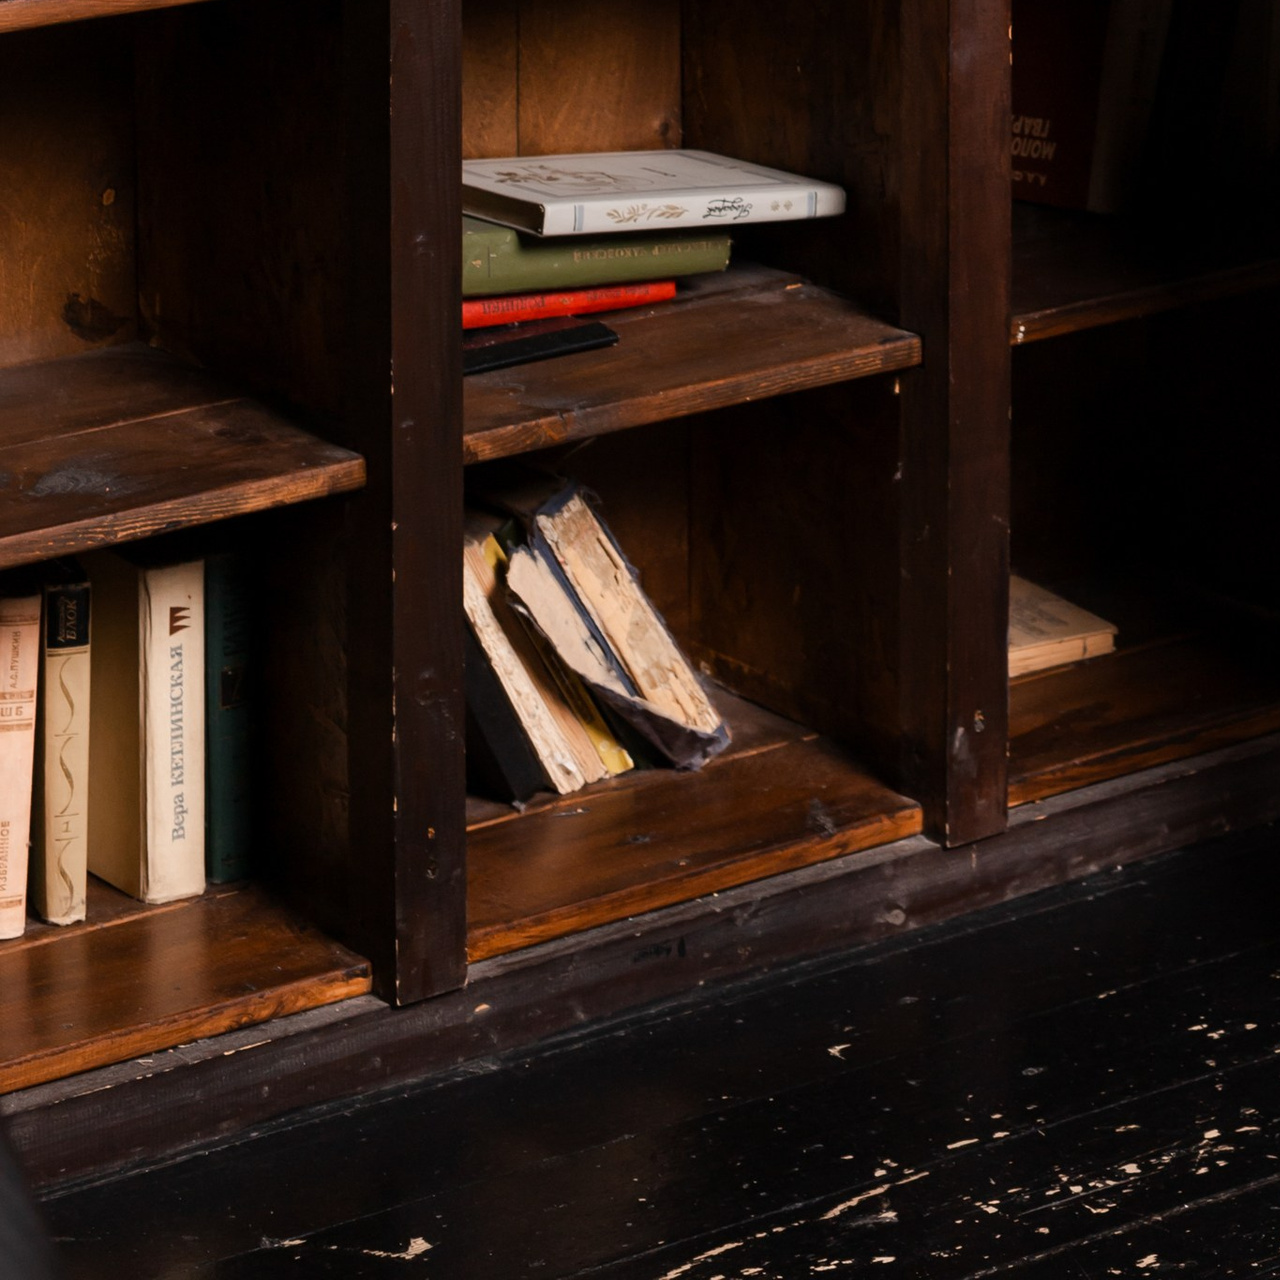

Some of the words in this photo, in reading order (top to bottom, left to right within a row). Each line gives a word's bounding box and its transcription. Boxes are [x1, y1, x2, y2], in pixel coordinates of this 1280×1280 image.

[65, 599, 77, 640] БЛОК
[169, 643, 184, 789] КЕТЛИНСКАЯ
[171, 792, 188, 842] Вера
